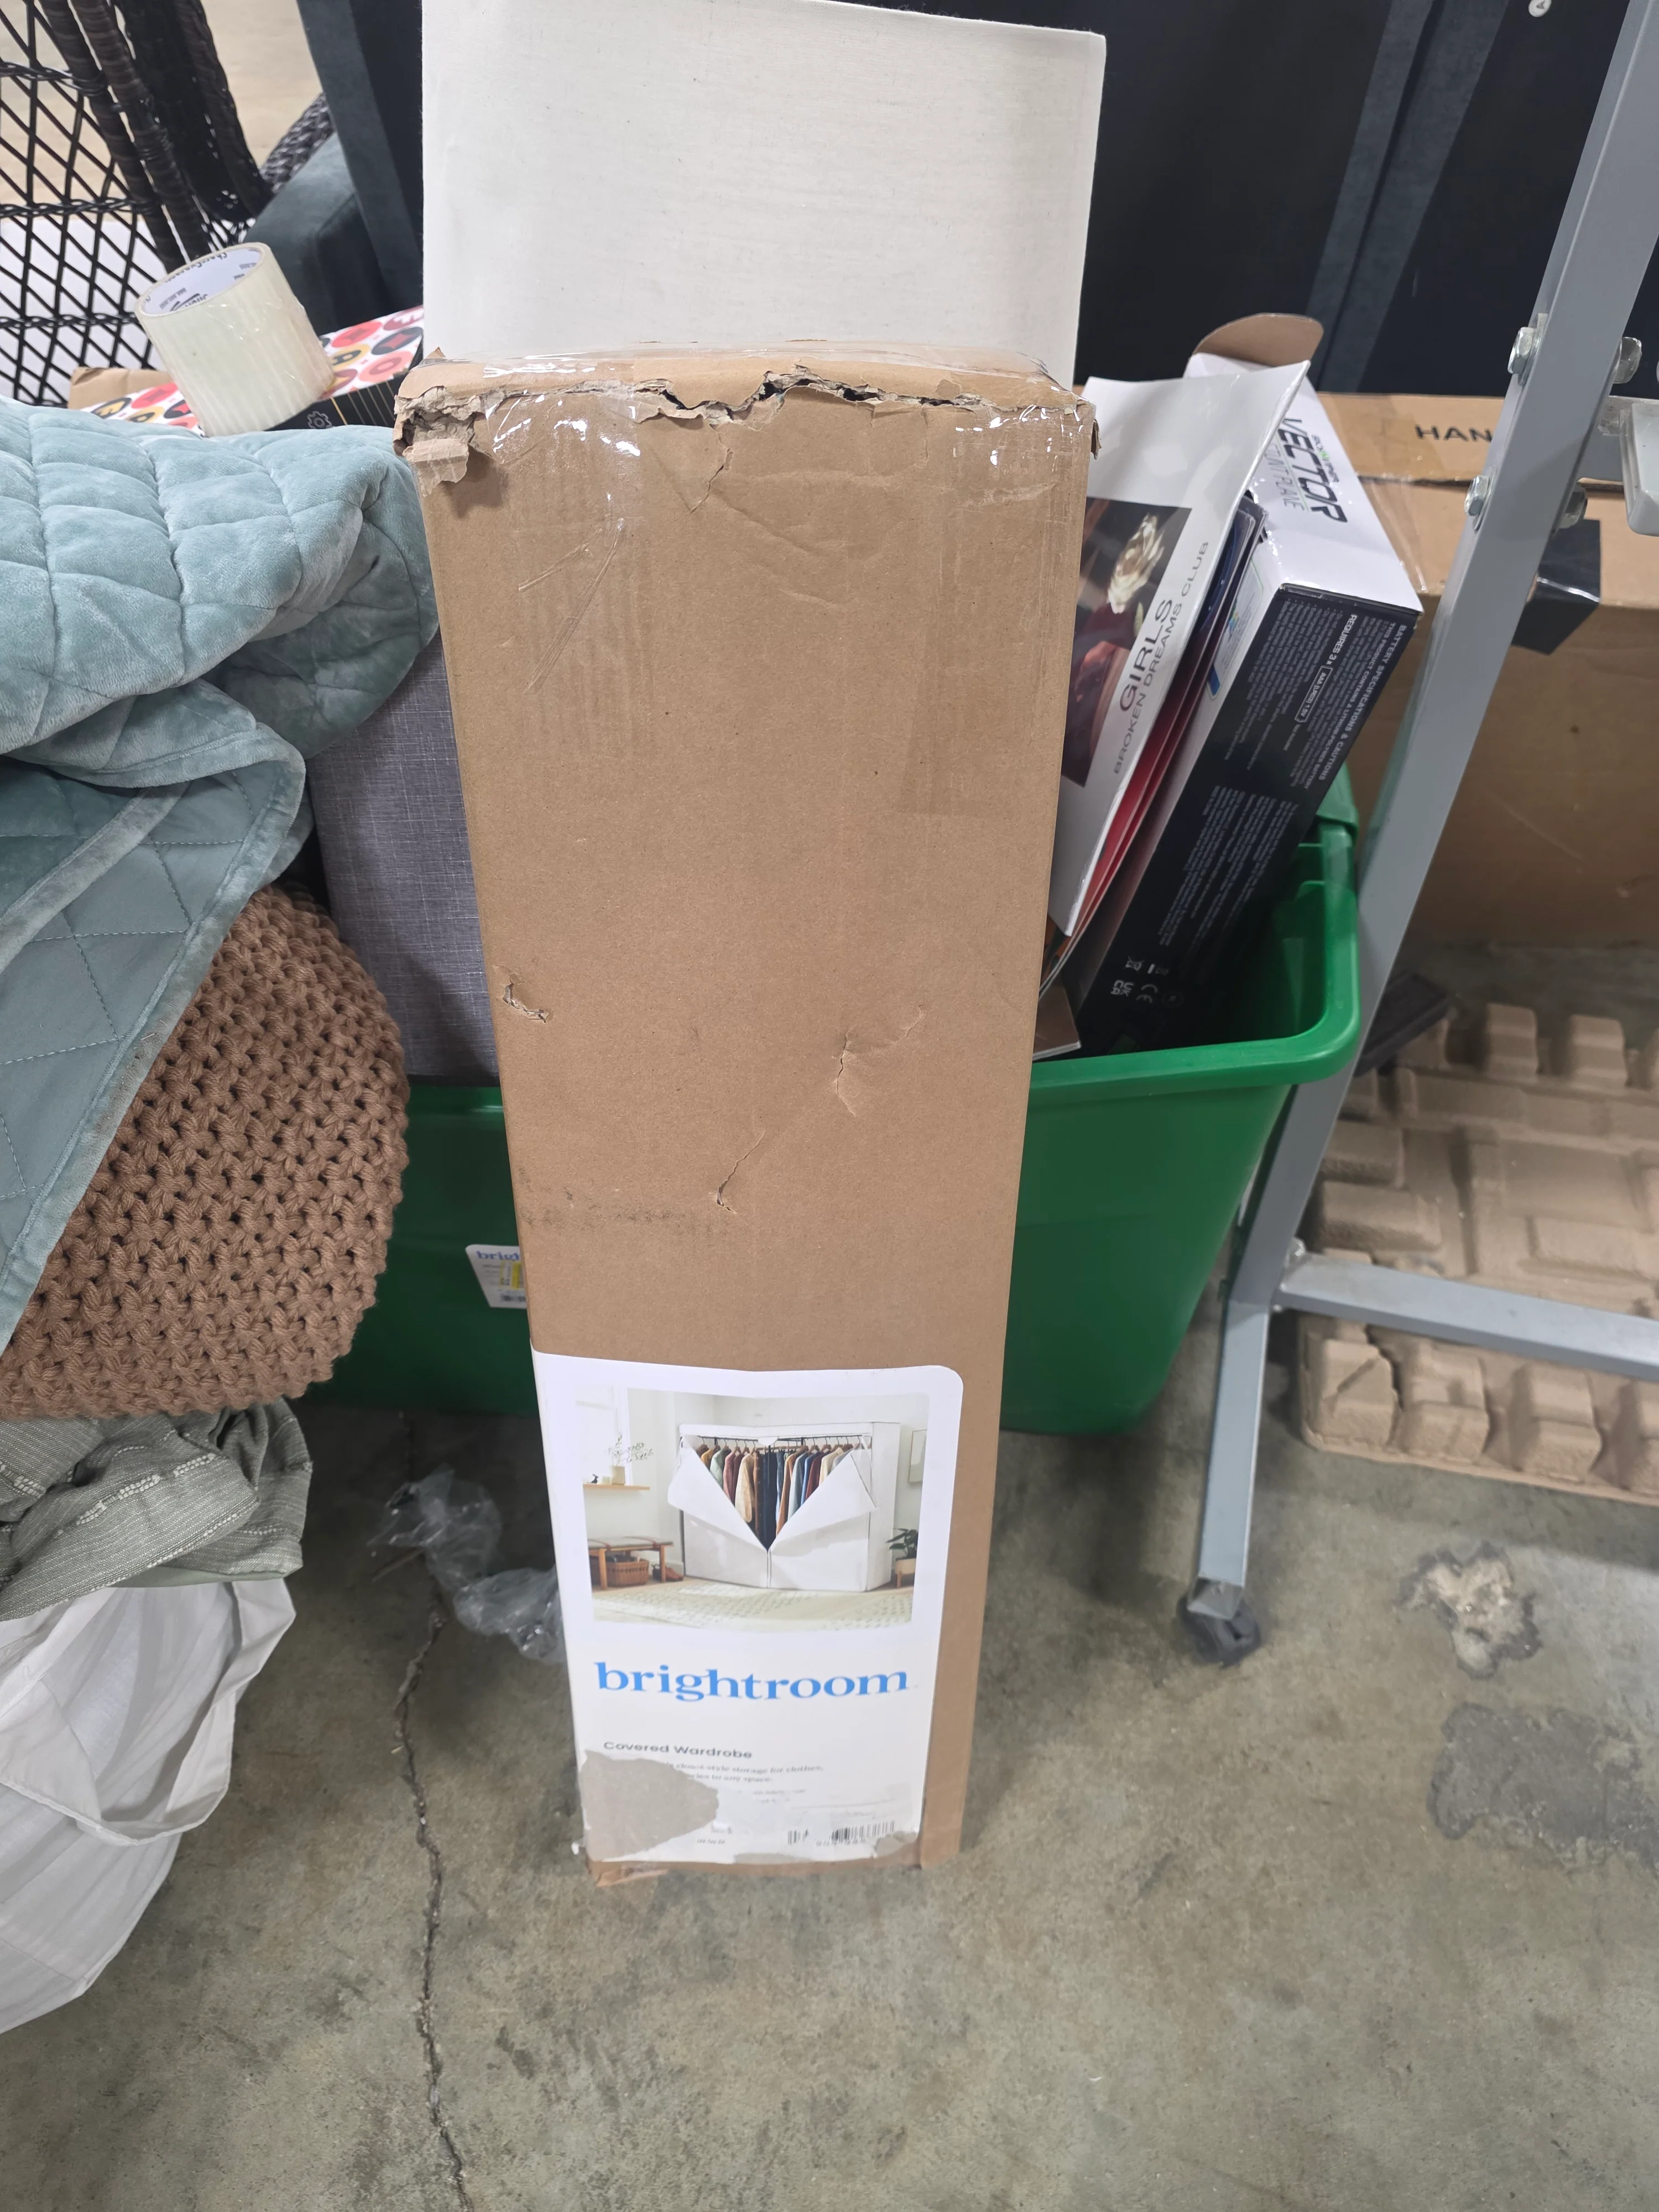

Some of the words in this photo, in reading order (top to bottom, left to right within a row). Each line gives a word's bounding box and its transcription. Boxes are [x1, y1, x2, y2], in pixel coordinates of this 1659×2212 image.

[1277, 418, 1348, 523] VECTOR
[1333, 614, 1358, 653] REQUIRES
[1383, 625, 1407, 664] BATTERY
[1384, 623, 1396, 638] THIS
[1114, 694, 1146, 774] BROKEN
[1143, 603, 1182, 687] DREAMS
[1181, 541, 1208, 597] CLUB
[1120, 599, 1172, 711] GIRLS
[1366, 639, 1387, 670] PRODUCT
[1316, 672, 1327, 685] AAA
[1348, 671, 1370, 703] CONTAINS
[1345, 665, 1385, 732] SPECIFICATIONS
[1318, 741, 1344, 781] CAUTIONS
[593, 1661, 908, 1703] brightroom
[603, 1741, 670, 1754] Covered
[674, 1745, 753, 1759] Wardrobe
